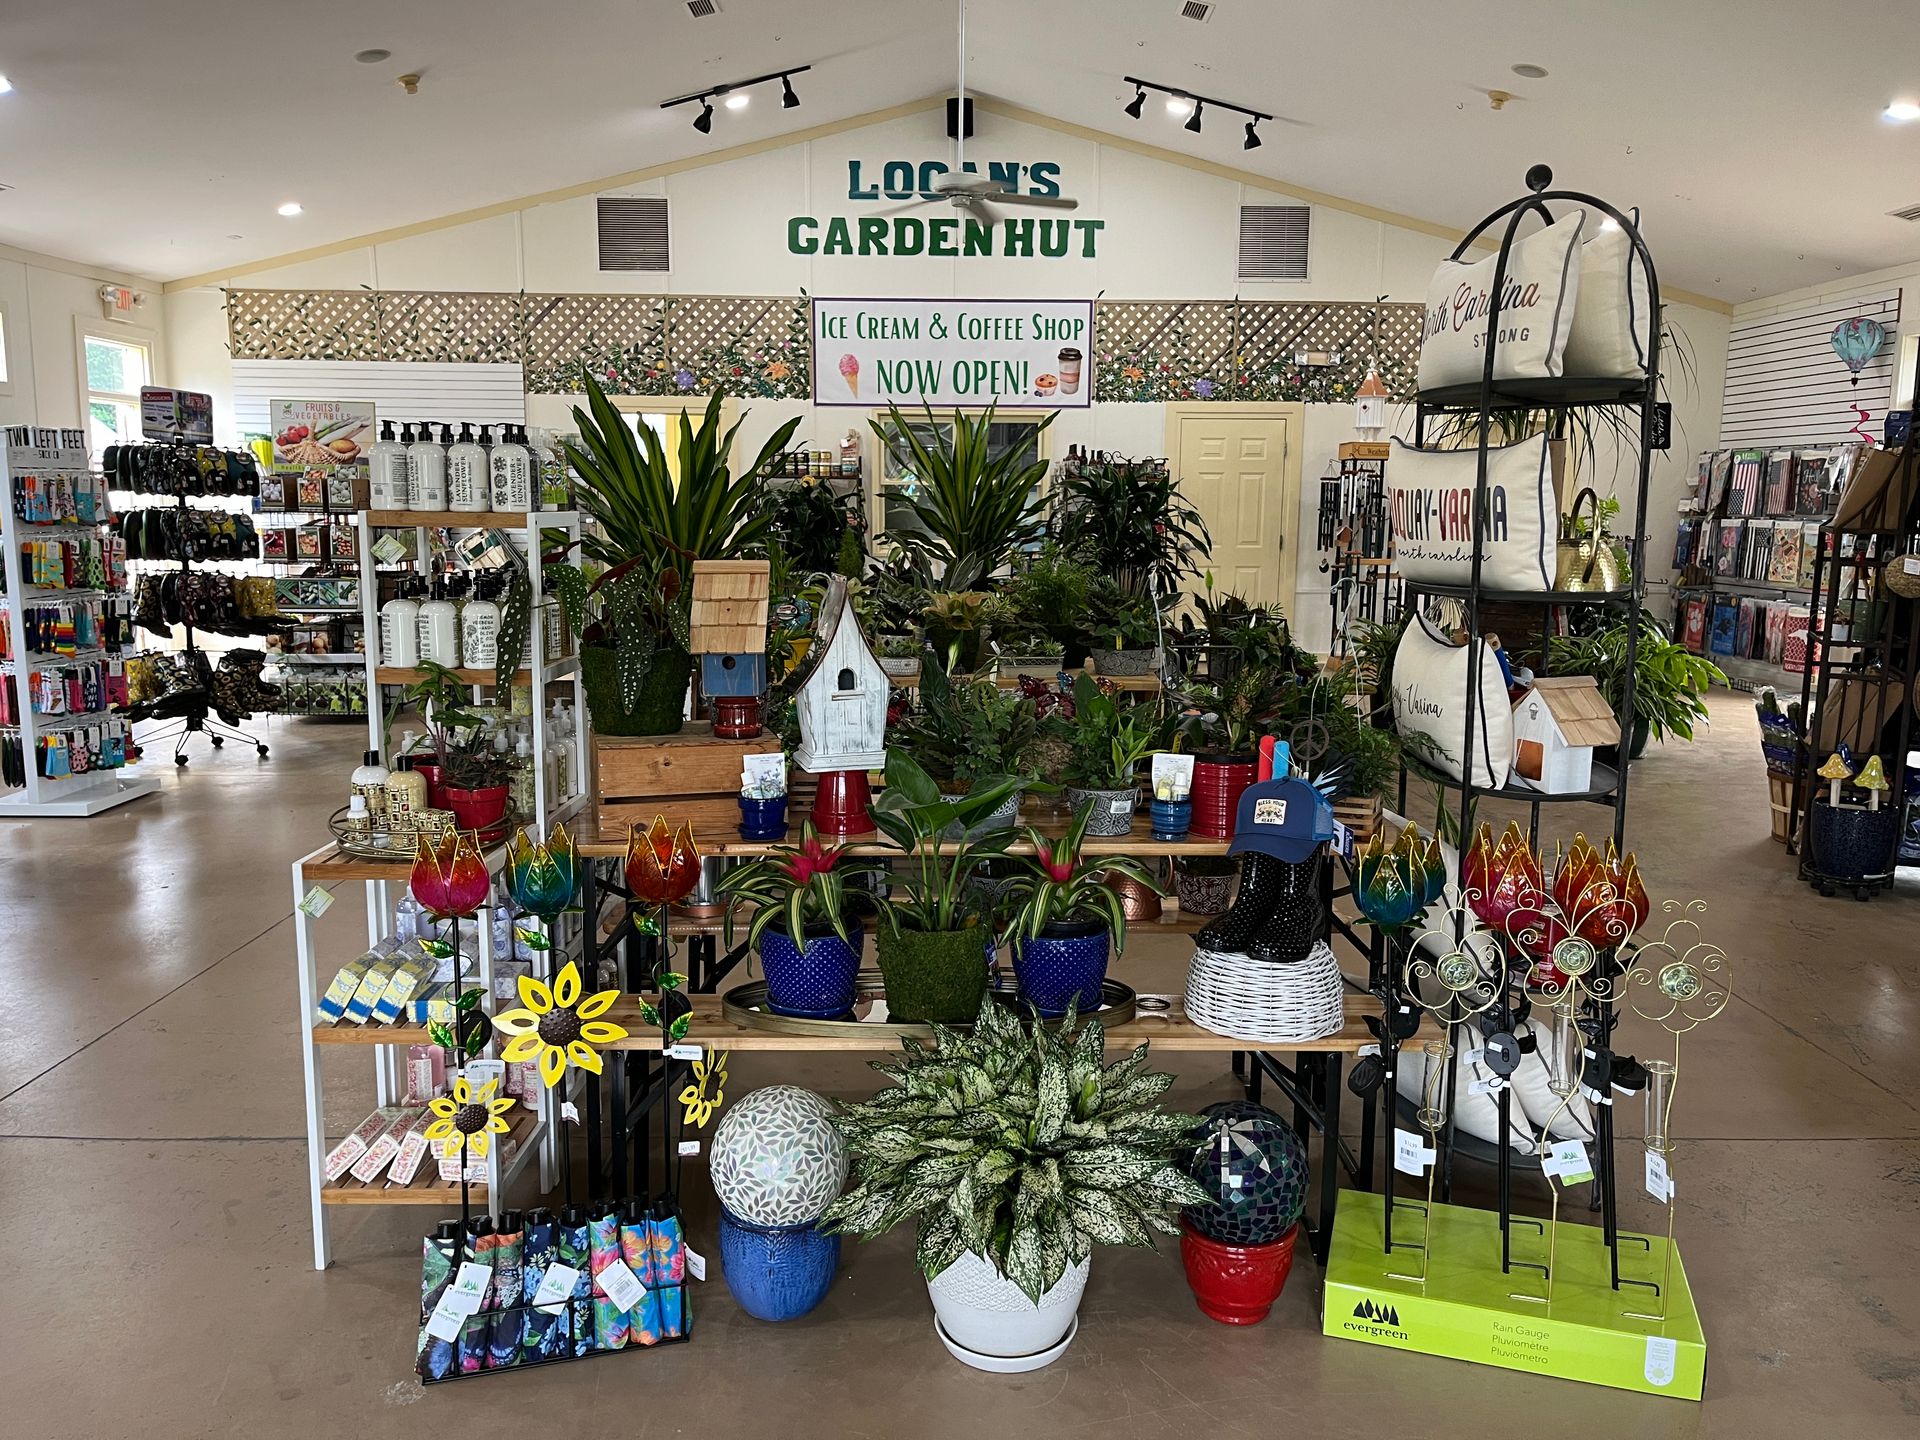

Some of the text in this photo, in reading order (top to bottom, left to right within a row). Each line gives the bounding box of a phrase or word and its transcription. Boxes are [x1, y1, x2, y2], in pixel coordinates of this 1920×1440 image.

[821, 311, 1084, 341] ICE CREAM & COFFEE SHOP
[1473, 327, 1530, 348] STONG
[876, 359, 1029, 395] NOW OPEN!
[295, 411, 352, 421] VEGETABLES
[305, 402, 340, 412] FRUITS &
[6, 427, 85, 449] TWO LEFT FEET
[454, 462, 462, 502] LAVENDER
[460, 455, 468, 502] SUNFLOWER
[516, 457, 524, 503] SUNFLOWER
[1388, 485, 1508, 542] UQUAY-VARINA
[436, 1311, 461, 1325] evergreen
[1343, 1321, 1409, 1341] evergreen
[1493, 1321, 1550, 1340] Rain Gauge
